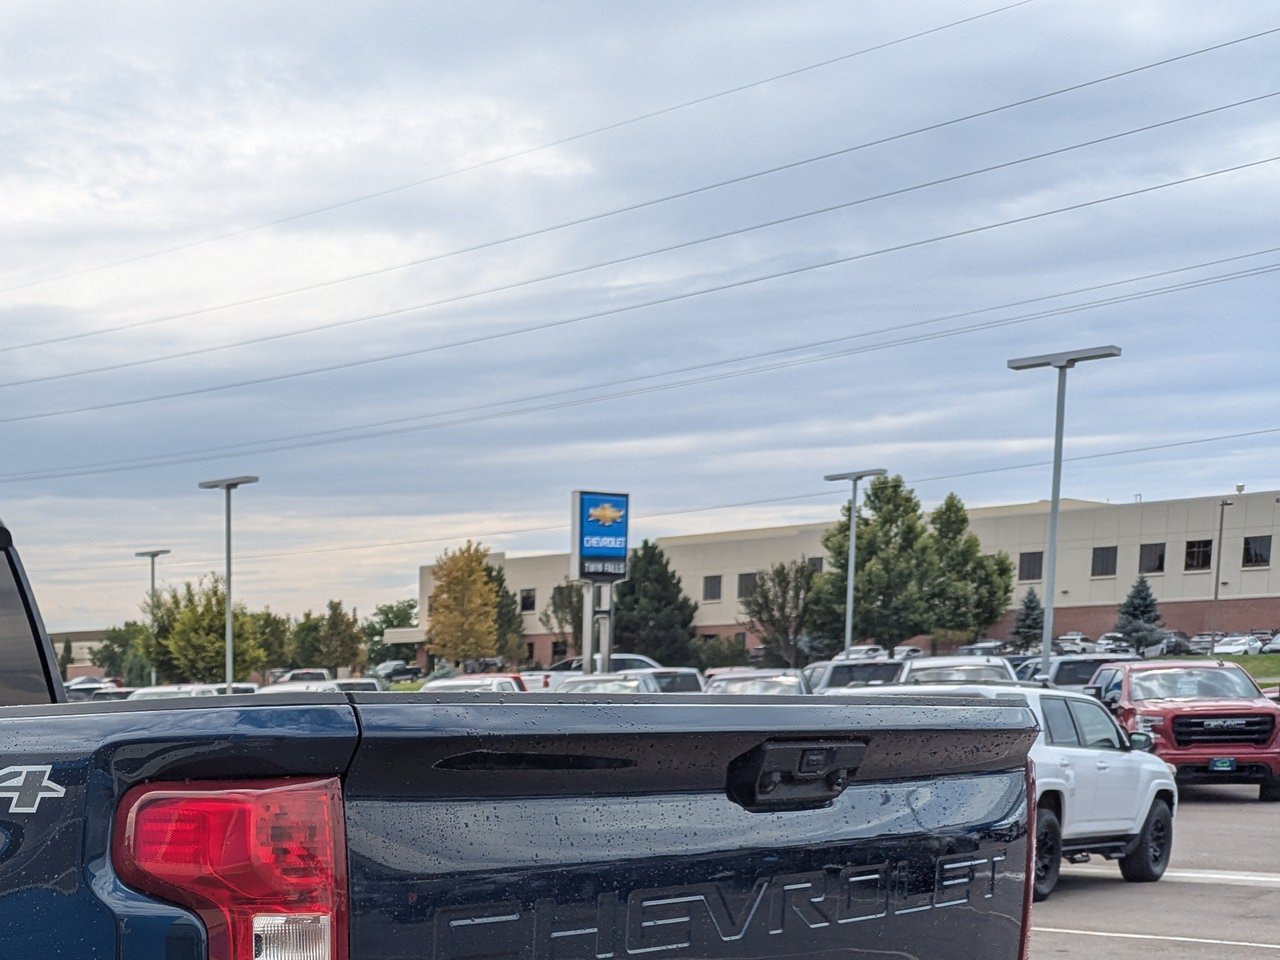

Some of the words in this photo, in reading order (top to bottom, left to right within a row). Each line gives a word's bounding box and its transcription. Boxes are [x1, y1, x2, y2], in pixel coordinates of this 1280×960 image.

[584, 536, 625, 548] CHEVROLET
[584, 561, 602, 573] TWIN
[604, 562, 625, 574] FALLS
